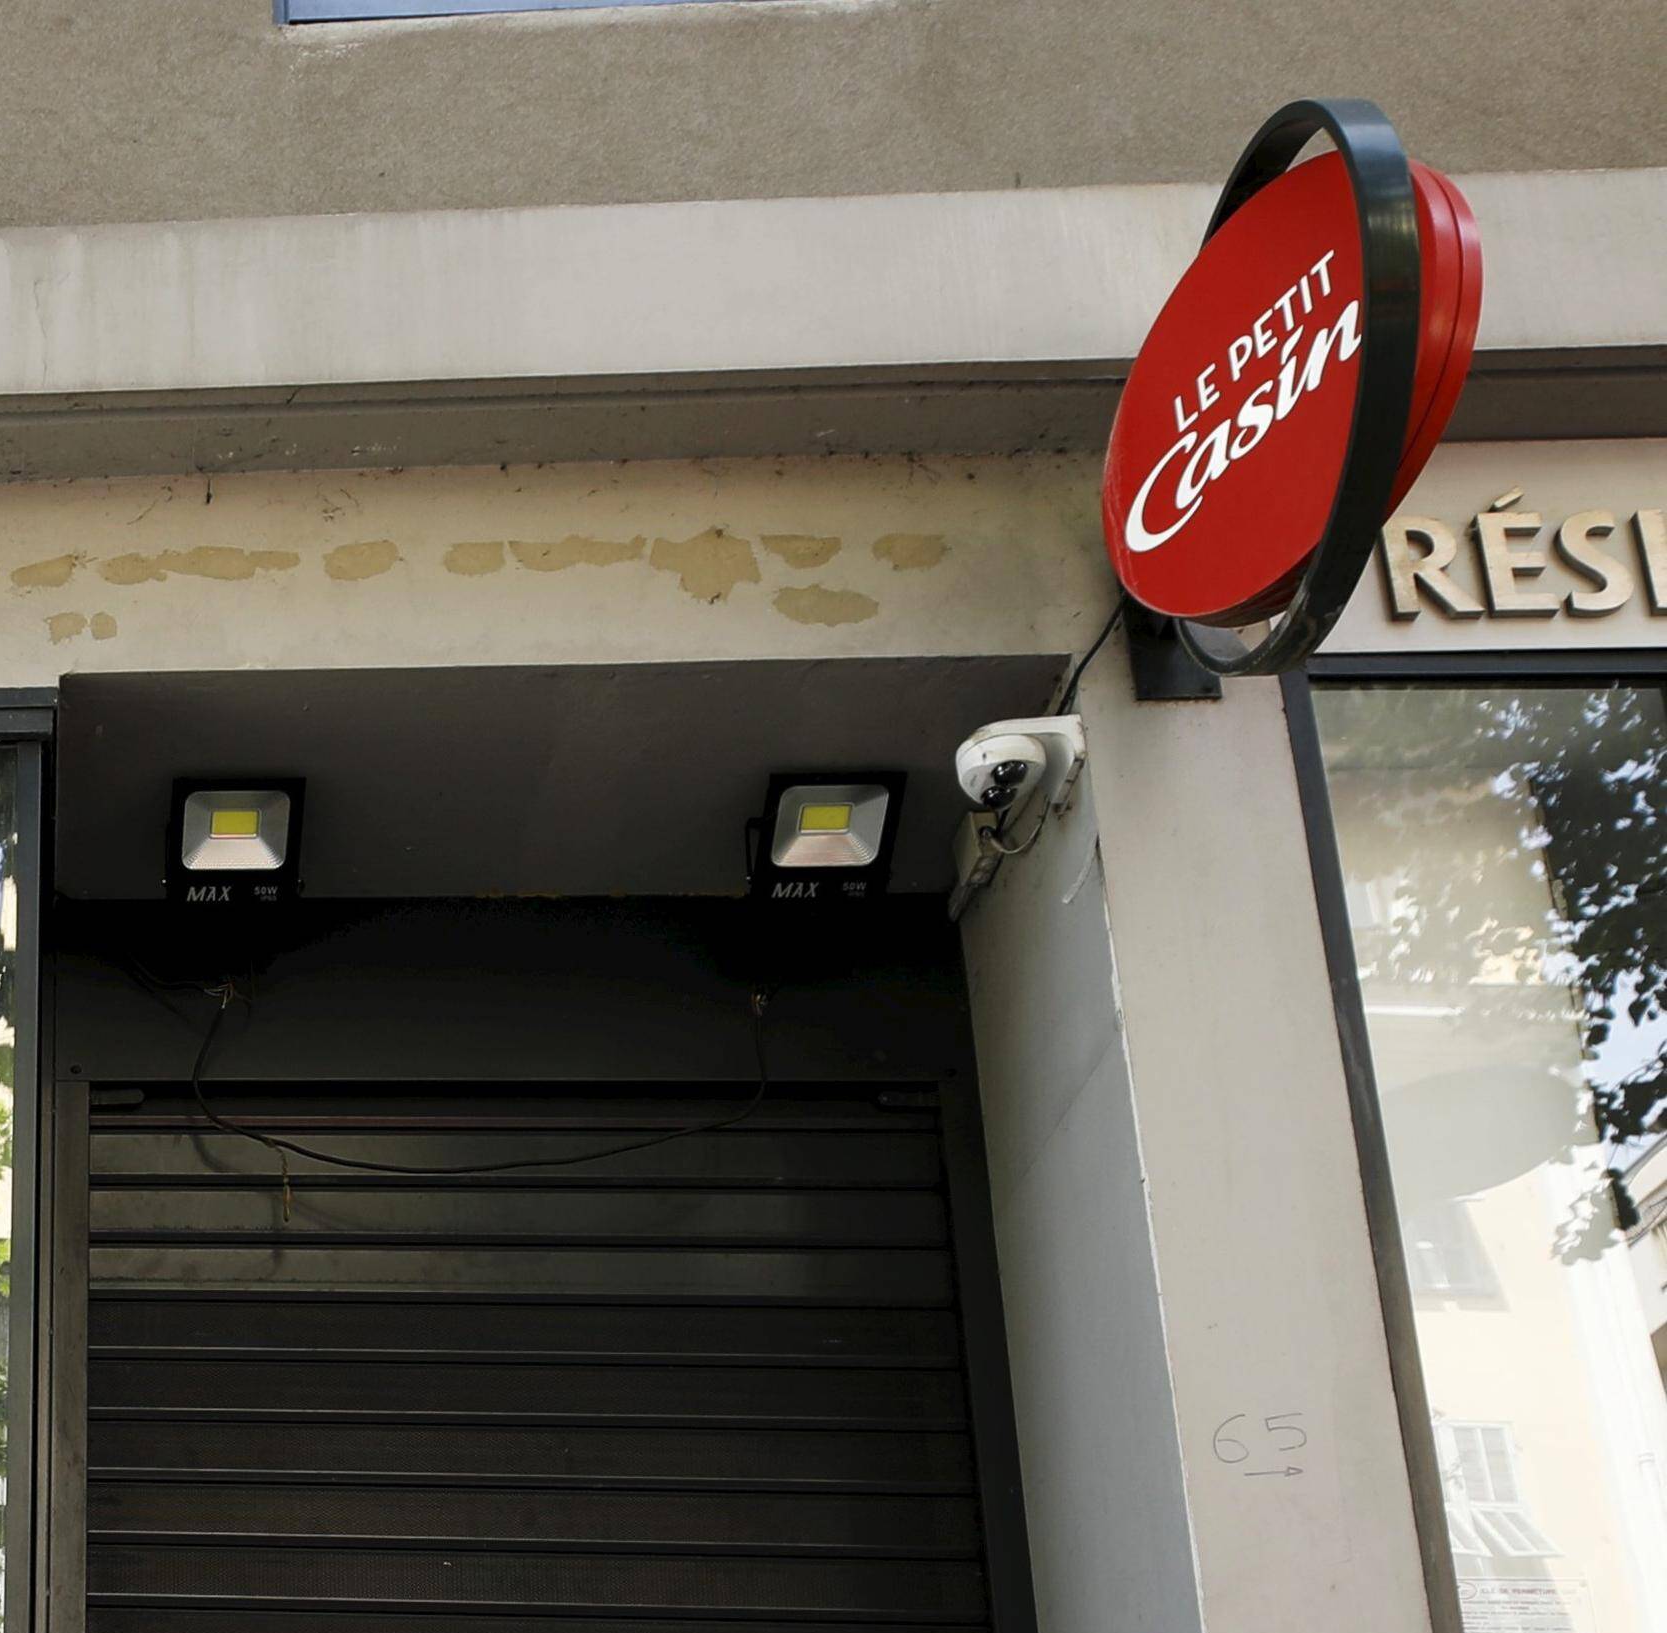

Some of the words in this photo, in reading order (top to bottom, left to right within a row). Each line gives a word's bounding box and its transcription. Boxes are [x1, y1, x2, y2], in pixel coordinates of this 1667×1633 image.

[1172, 363, 1217, 433] LE
[1227, 249, 1334, 381] PETIT
[1124, 299, 1362, 553] Casin
[186, 885, 232, 902] MAX
[771, 882, 819, 899] MAX
